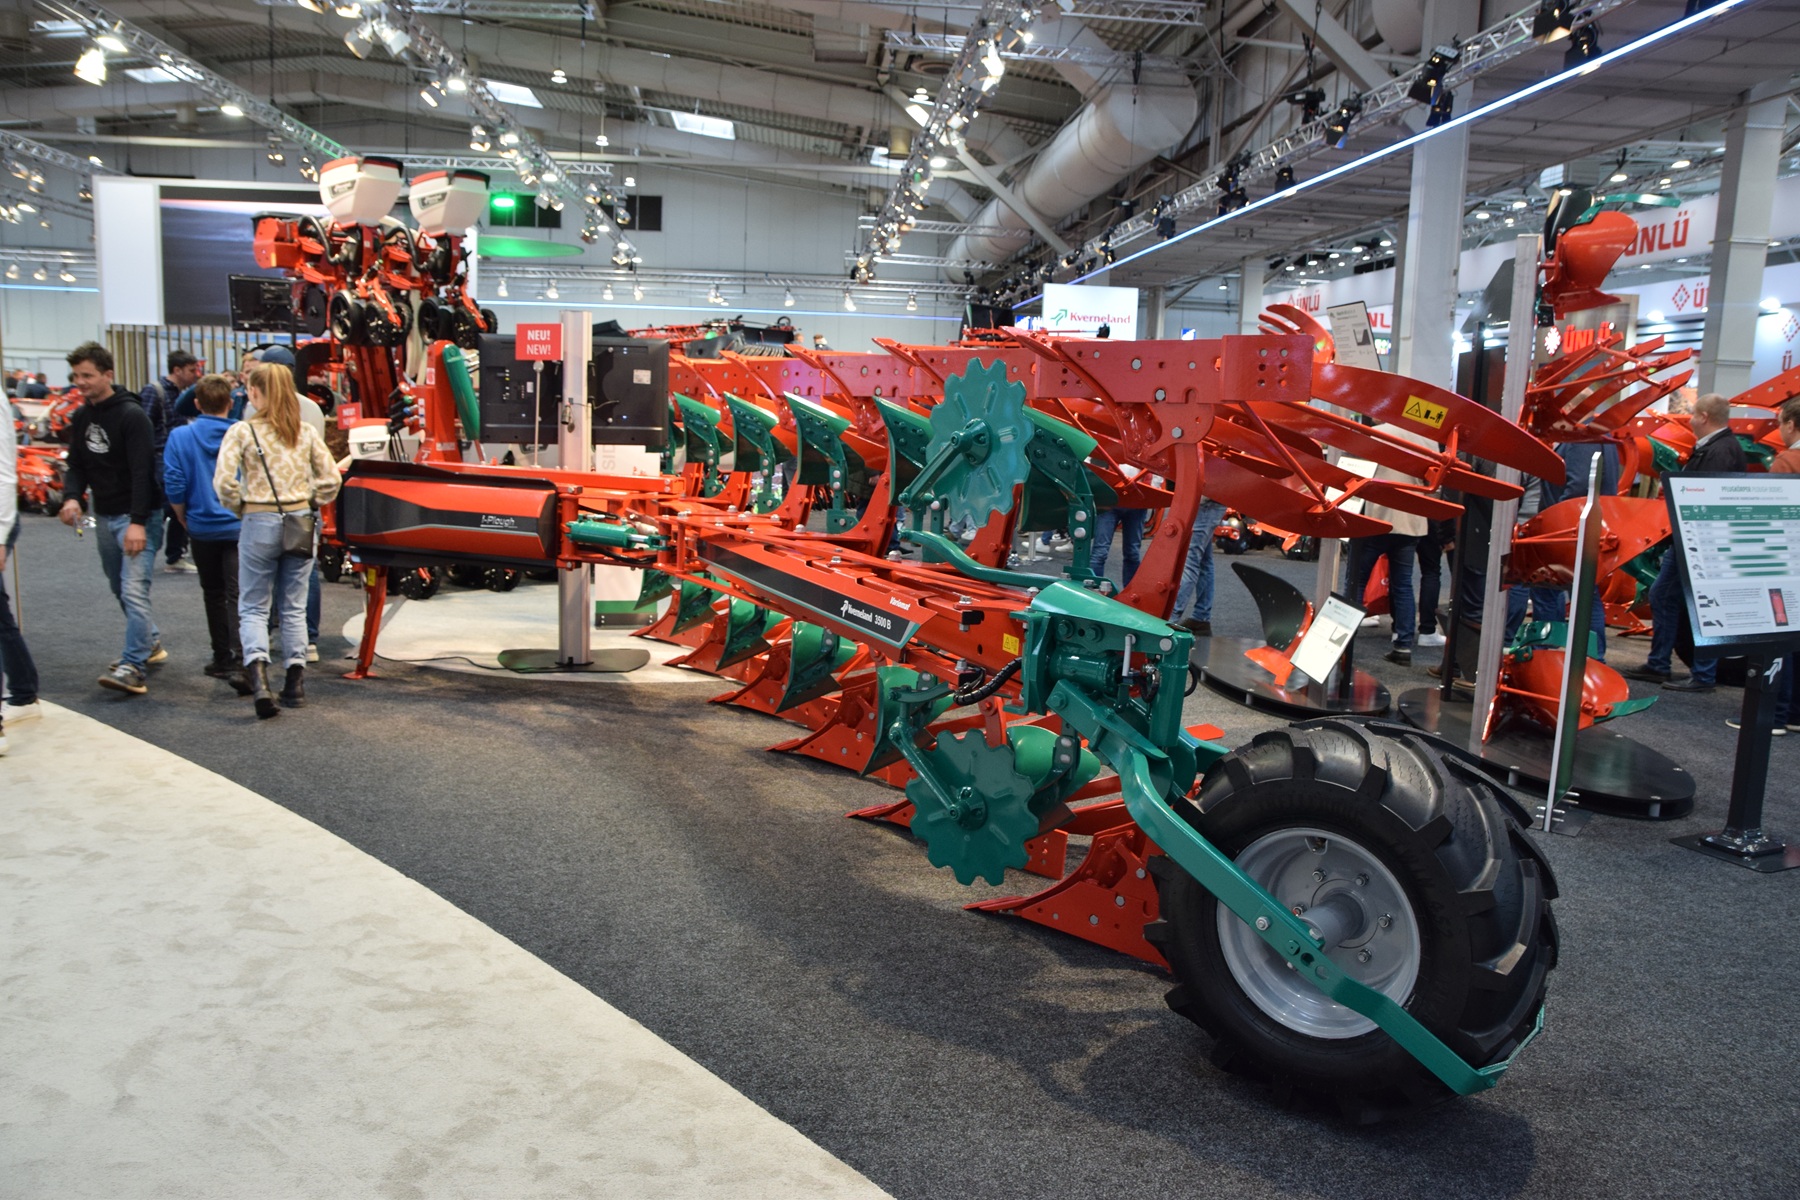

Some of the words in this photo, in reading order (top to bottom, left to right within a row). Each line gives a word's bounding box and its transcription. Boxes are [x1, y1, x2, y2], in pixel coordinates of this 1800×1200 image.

[1069, 311, 1131, 324] Kverneland
[527, 329, 551, 341] NEU!
[526, 344, 551, 355] NEW!
